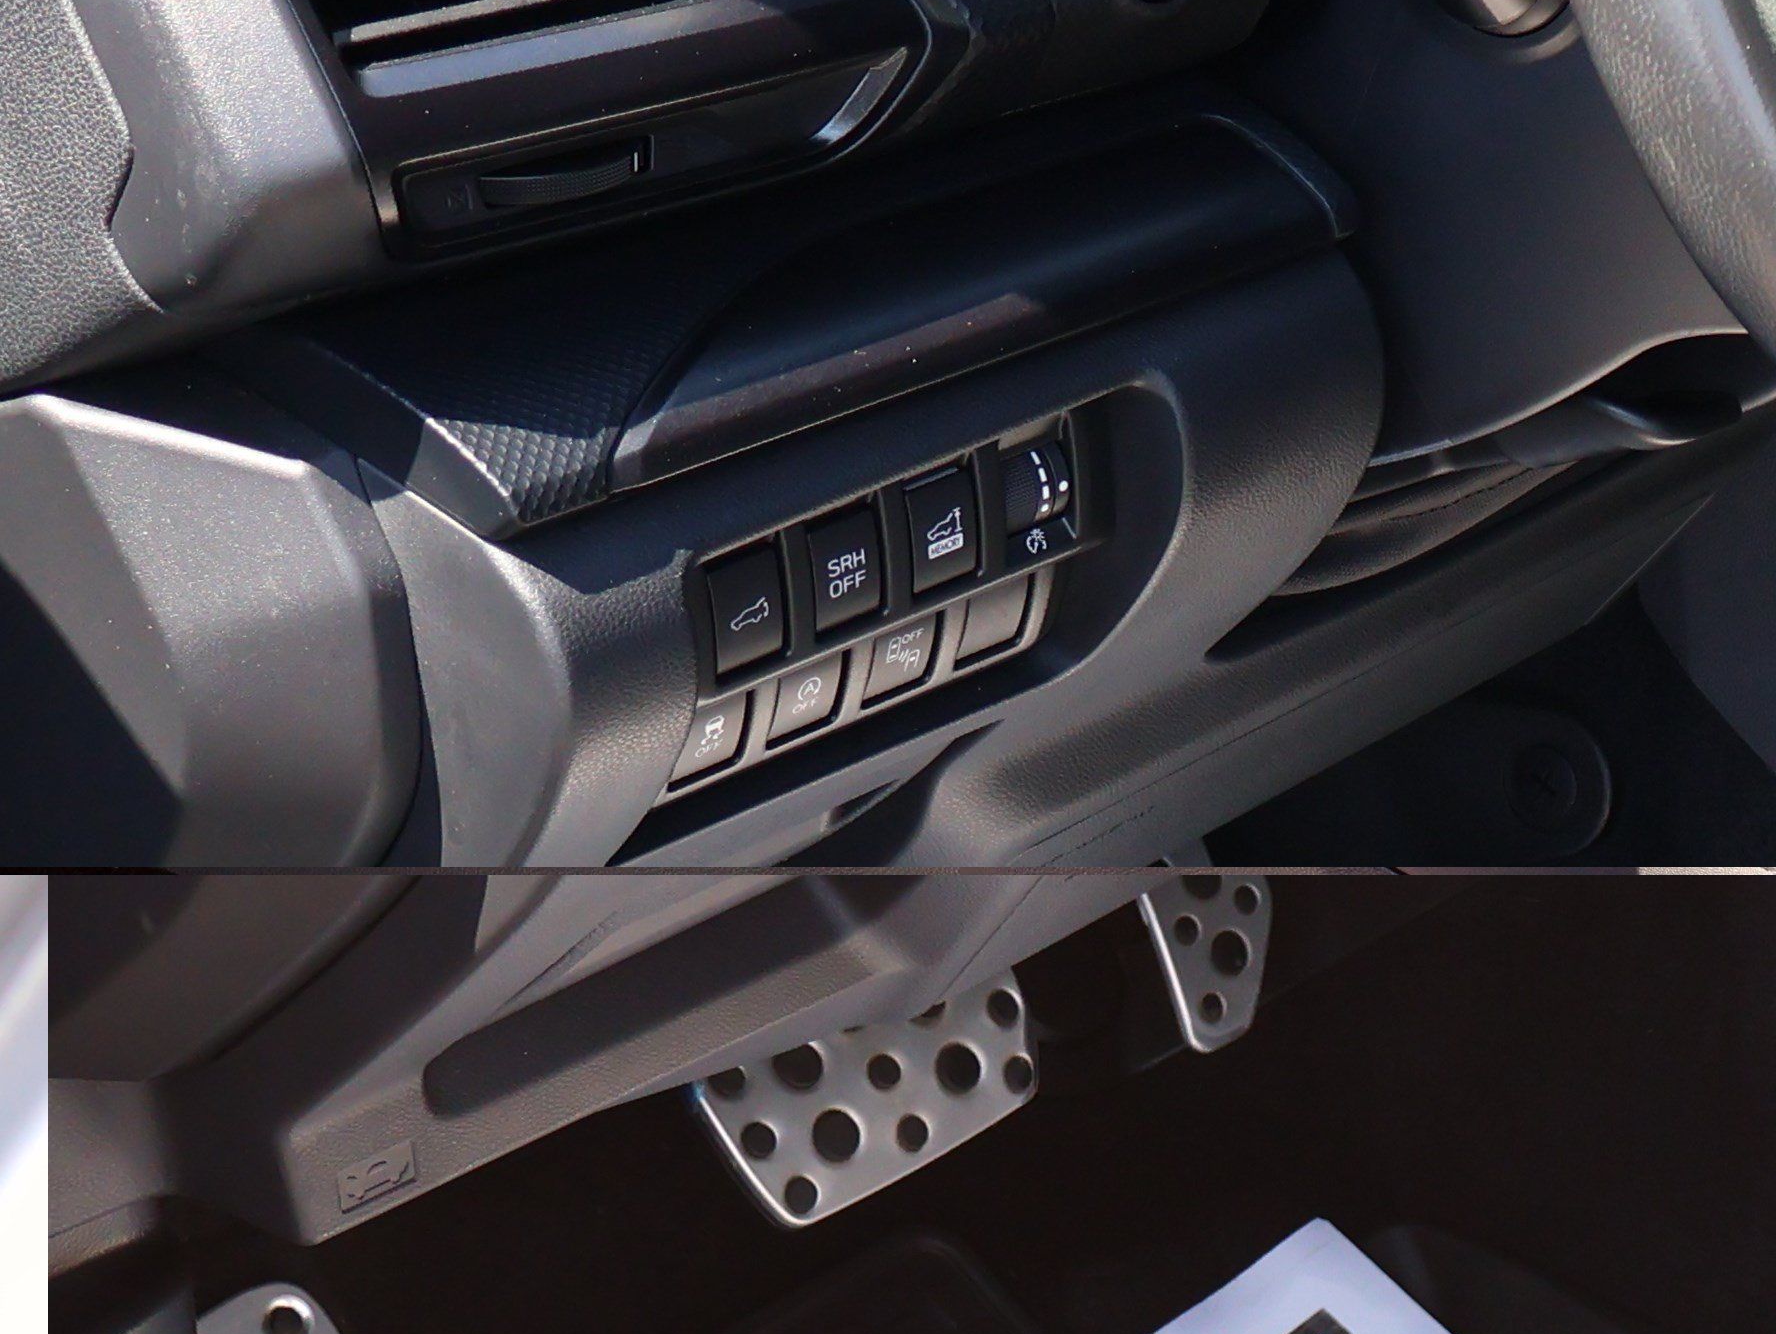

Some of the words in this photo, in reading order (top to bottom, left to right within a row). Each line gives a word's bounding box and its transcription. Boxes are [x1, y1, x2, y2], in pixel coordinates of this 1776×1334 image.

[929, 536, 962, 557] MEMORY
[827, 548, 866, 579] SRH
[828, 570, 867, 599] OFF
[901, 628, 924, 644] OFF
[792, 699, 817, 715] OFF
